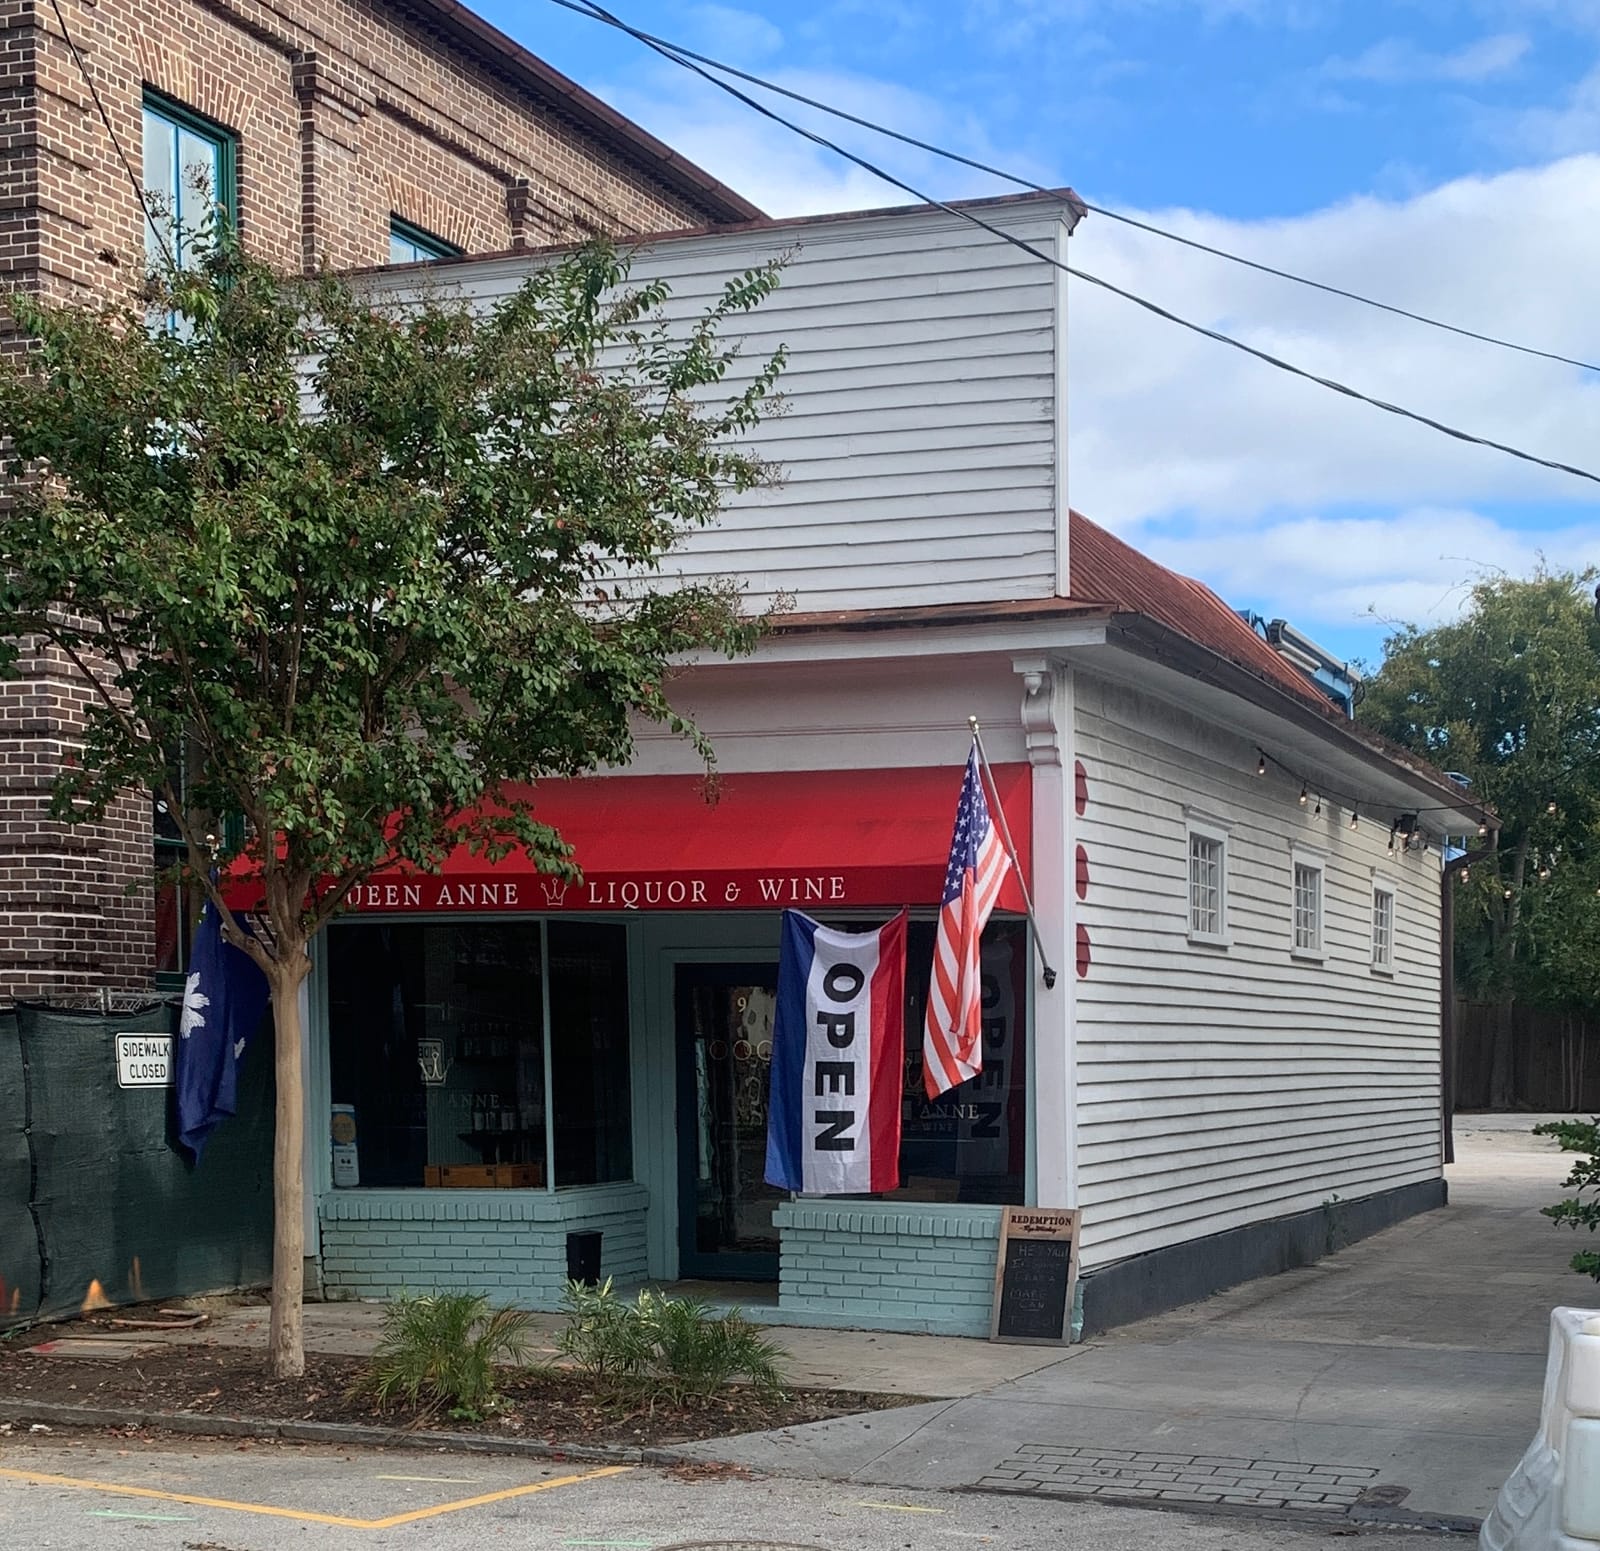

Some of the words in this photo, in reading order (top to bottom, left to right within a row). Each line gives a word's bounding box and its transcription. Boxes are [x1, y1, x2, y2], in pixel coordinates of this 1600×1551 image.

[323, 884, 422, 906] UEEN
[435, 883, 519, 906] ANNE
[588, 880, 708, 910] LIQUOR
[724, 881, 741, 902] &
[758, 876, 846, 901] WINE
[122, 1042, 170, 1057] SIDEWALK
[814, 962, 865, 1152] OPEN
[129, 1063, 166, 1079] CLOSED
[447, 1093, 500, 1109] ANNE
[919, 1103, 980, 1120] ANNE
[1011, 1215, 1072, 1226] REDEMPTION
